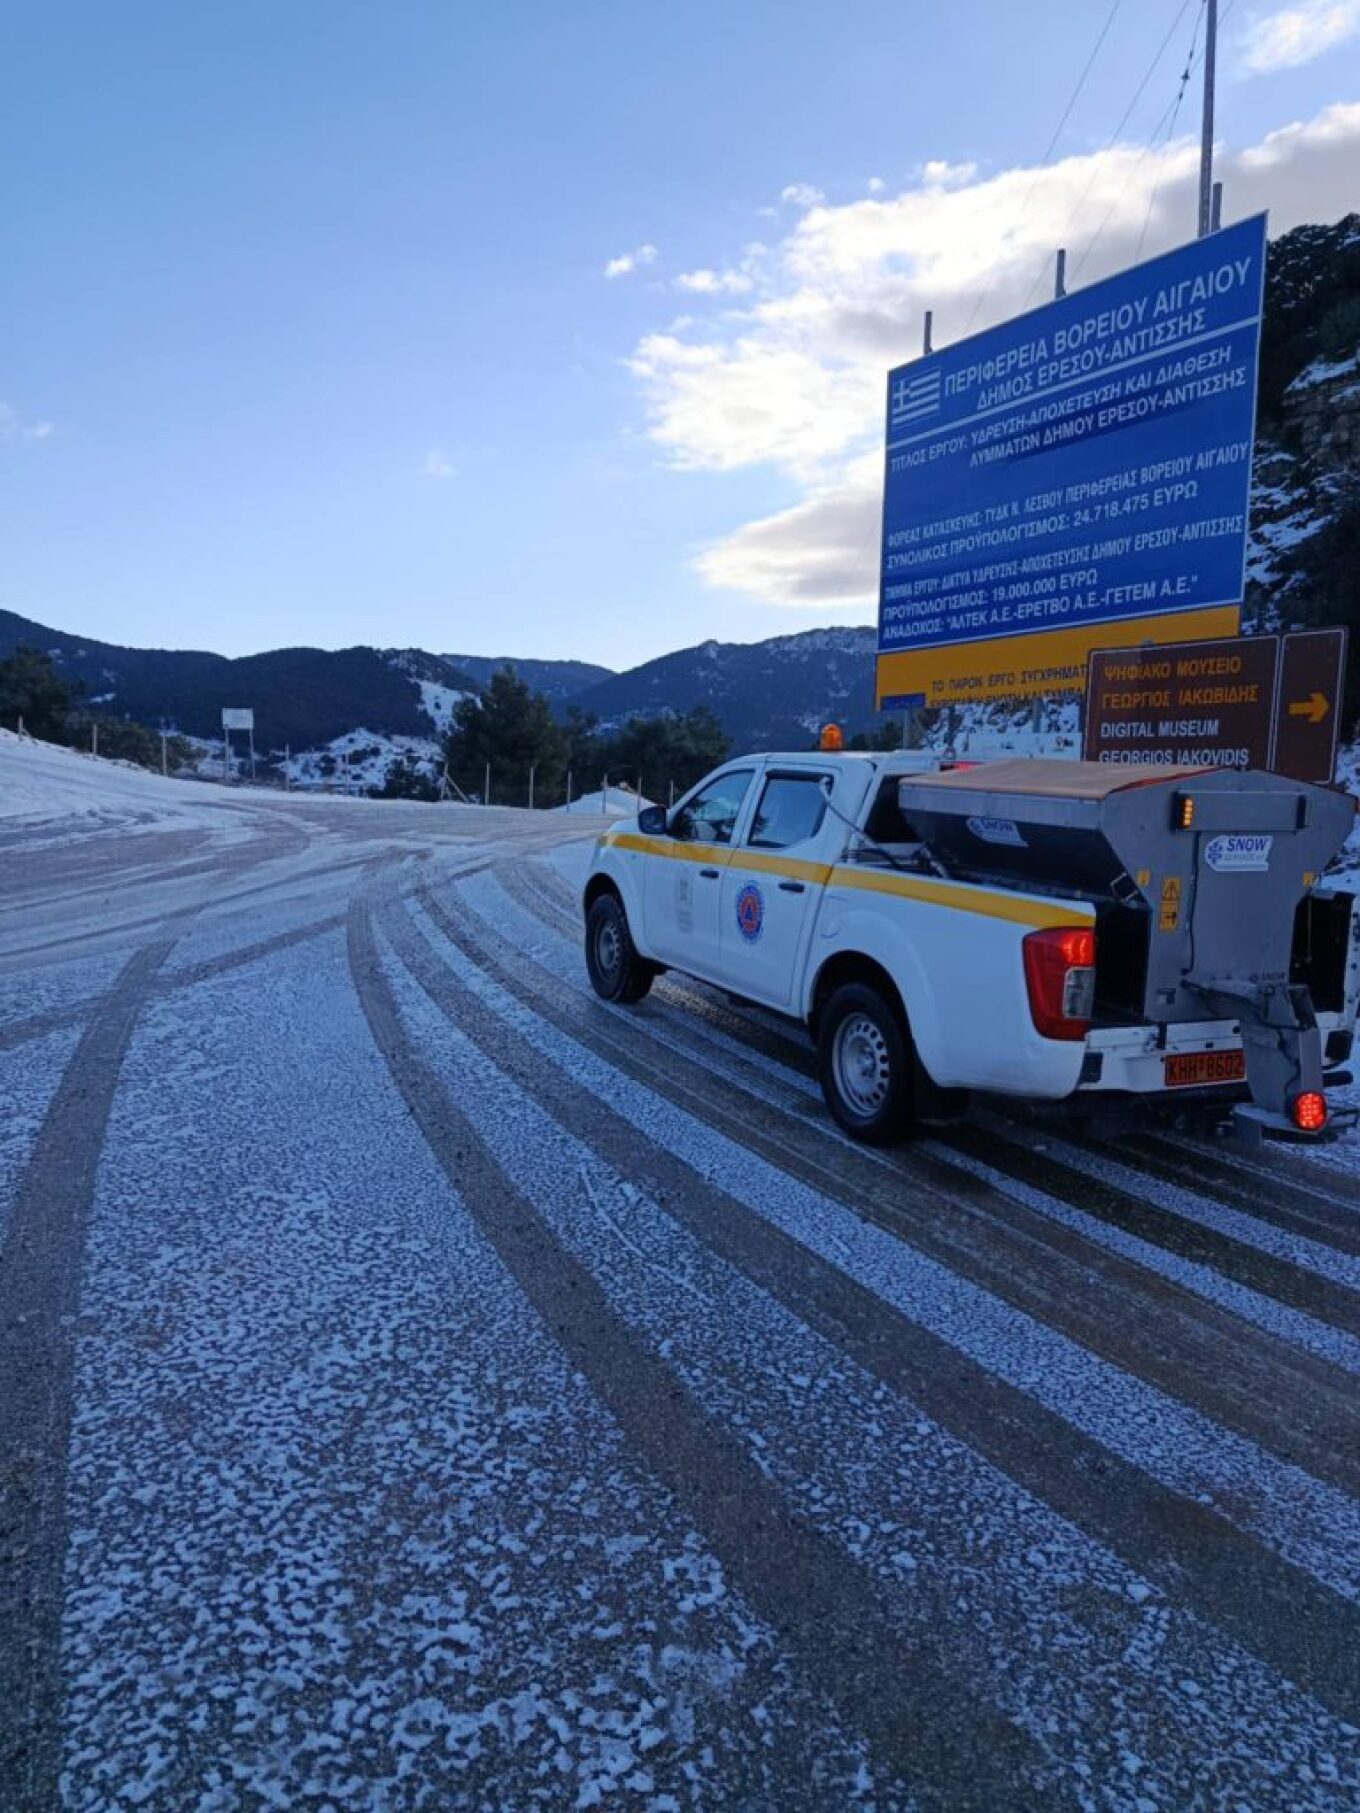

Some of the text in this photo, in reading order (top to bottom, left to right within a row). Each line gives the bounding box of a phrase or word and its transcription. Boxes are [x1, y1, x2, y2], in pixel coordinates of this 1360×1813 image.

[945, 256, 1251, 397] ΠΕΡΙΦΕΡΕΙΑ ΒΟΡΕΙΟΥ ΑΙΓΑΙΟΥ
[977, 308, 1205, 410] ΔΗΜΟΣ ΕΡΕΣΟΥ-ΑΝΤΙΣΣΗΣ
[891, 449, 928, 472] ΤΙΤΛΟΣ
[971, 381, 1121, 445] ΥΔΡΕΥΣΗ-ΑΠΟΧΕΤΕΥΣΗ
[1125, 371, 1151, 395] ΚΑΙ
[1155, 345, 1232, 385] ΔΙΑΘΕΣΗ
[970, 366, 1247, 468] ΛΥΜΜΑΤΩΝ ΔΗΜΟΥ ΕΡΕΣΟΥ-ΑΝΤΙΣΣΗΣ
[1023, 489, 1063, 513] ΛΕΣΒΟΥ
[1065, 470, 1137, 504] ΠΕΡΙΦΕΡΕΙΑΣ
[1140, 453, 1194, 485] ΒΟΡΕΙΟΥ
[1195, 440, 1249, 471] ΑΙΓΑΙΟΥ
[887, 543, 948, 569] ΣΥΝΟΛΙΚΟΣ
[1073, 493, 1149, 527] 24.718.475
[1154, 480, 1198, 507] ΕΥΡΩ
[1092, 536, 1131, 560] ΔΗΜΟΥ
[1134, 514, 1244, 552] ΕΡΕΣΟΥ-ΑΝΤΙΣΣΗΣ
[992, 576, 1056, 602] 19.000.000
[1060, 568, 1098, 591] ΕΥΡΩ
[988, 672, 1015, 687] ΕΡΓΟ
[1104, 656, 1242, 681] ΨΗΦΙΑΚΟ ΜΟΥΣΕΙΟ
[1102, 690, 1170, 709] ΓΕΩΡΓΙΟΣ
[1179, 684, 1259, 706] ΙΑΚΩΒΙΔΗΣ
[1101, 719, 1219, 738] DIGITAL MUSEUM
[1099, 748, 1249, 766] GEORGIOS IAKOVIDIS
[1226, 837, 1268, 853] SNOW
